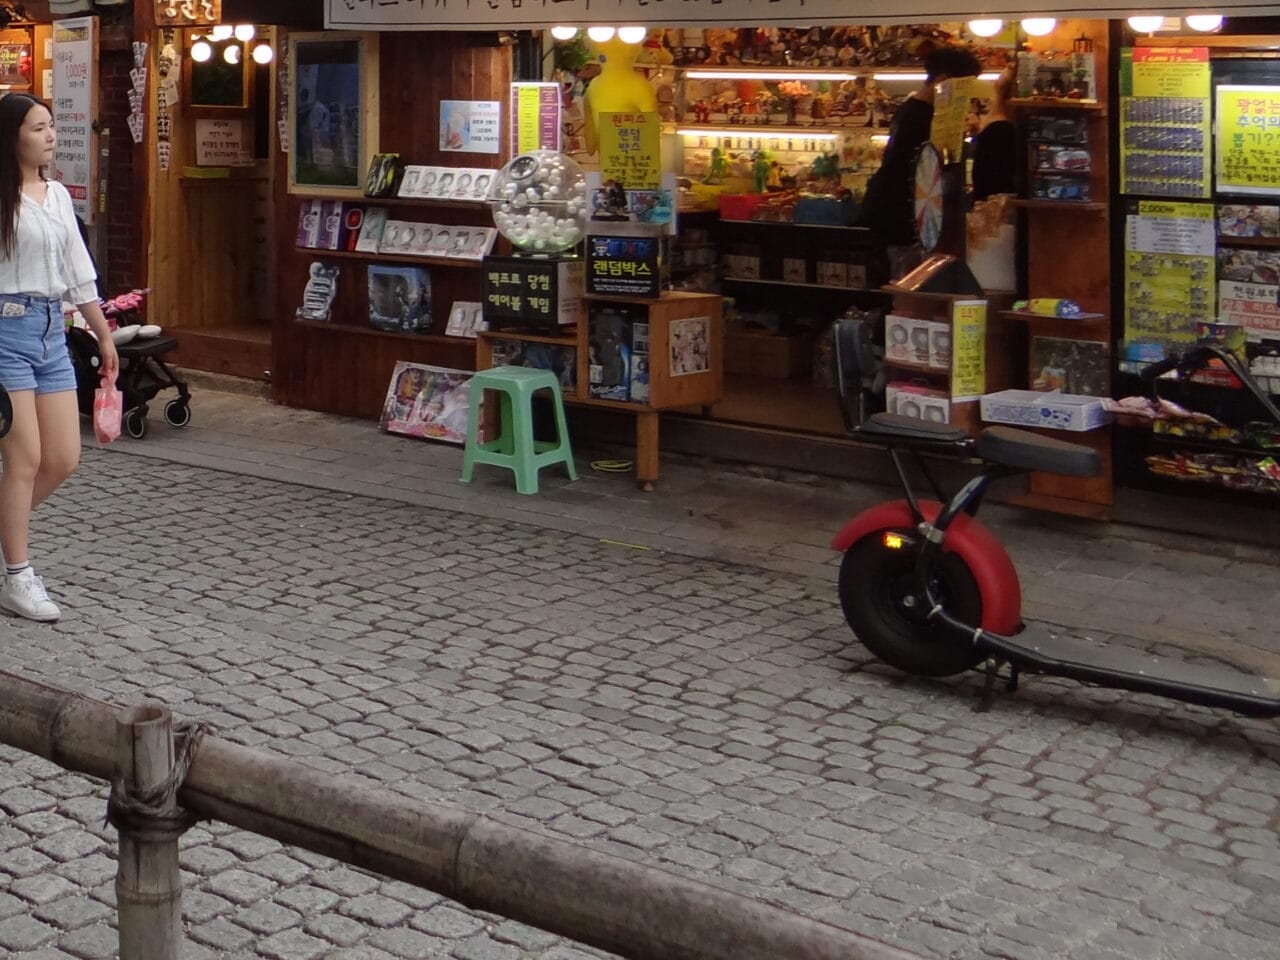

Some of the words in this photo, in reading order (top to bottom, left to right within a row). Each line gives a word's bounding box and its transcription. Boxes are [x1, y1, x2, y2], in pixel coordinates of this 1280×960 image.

[611, 113, 647, 127] 원피스
[617, 128, 641, 141] 랜덤
[618, 142, 641, 154] 박스
[593, 259, 652, 277] 랜덤박스
[527, 274, 551, 290] 당첨
[488, 293, 521, 312] 에어볼
[527, 296, 550, 313] 게임
